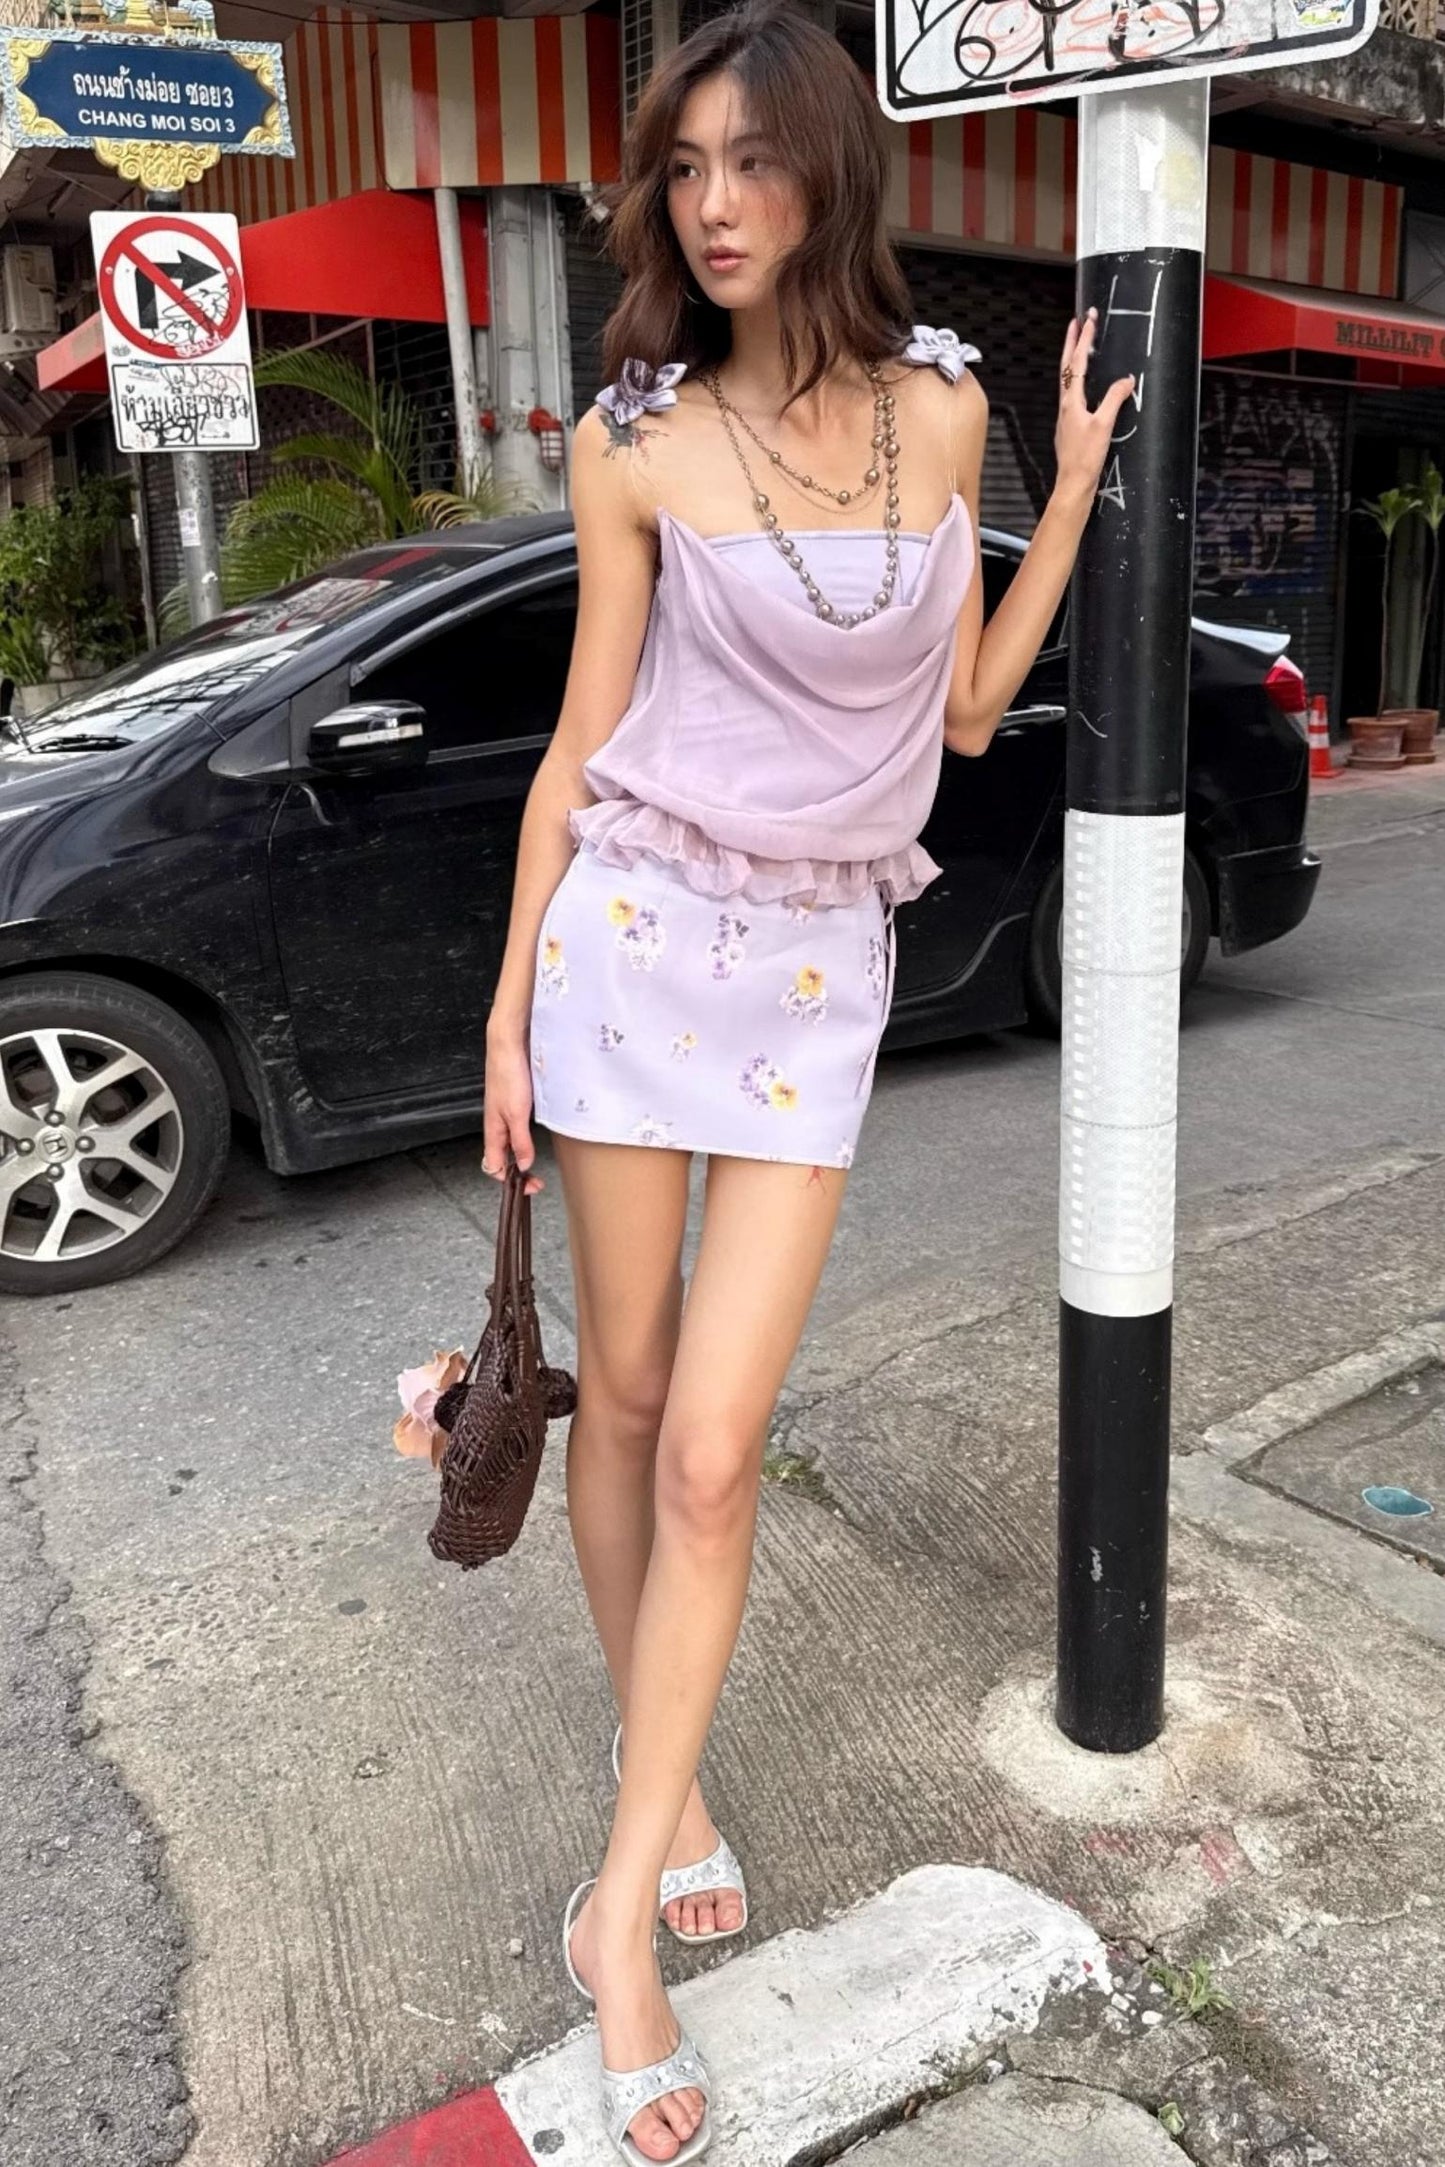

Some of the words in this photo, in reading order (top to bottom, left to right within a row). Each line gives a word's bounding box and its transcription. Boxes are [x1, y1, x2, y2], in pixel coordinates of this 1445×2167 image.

[73, 66, 180, 103] ถนนช้างม่อย
[79, 109, 146, 128] CHANG
[152, 114, 185, 131] MOI
[190, 117, 221, 133] SOI
[225, 118, 236, 133] 3
